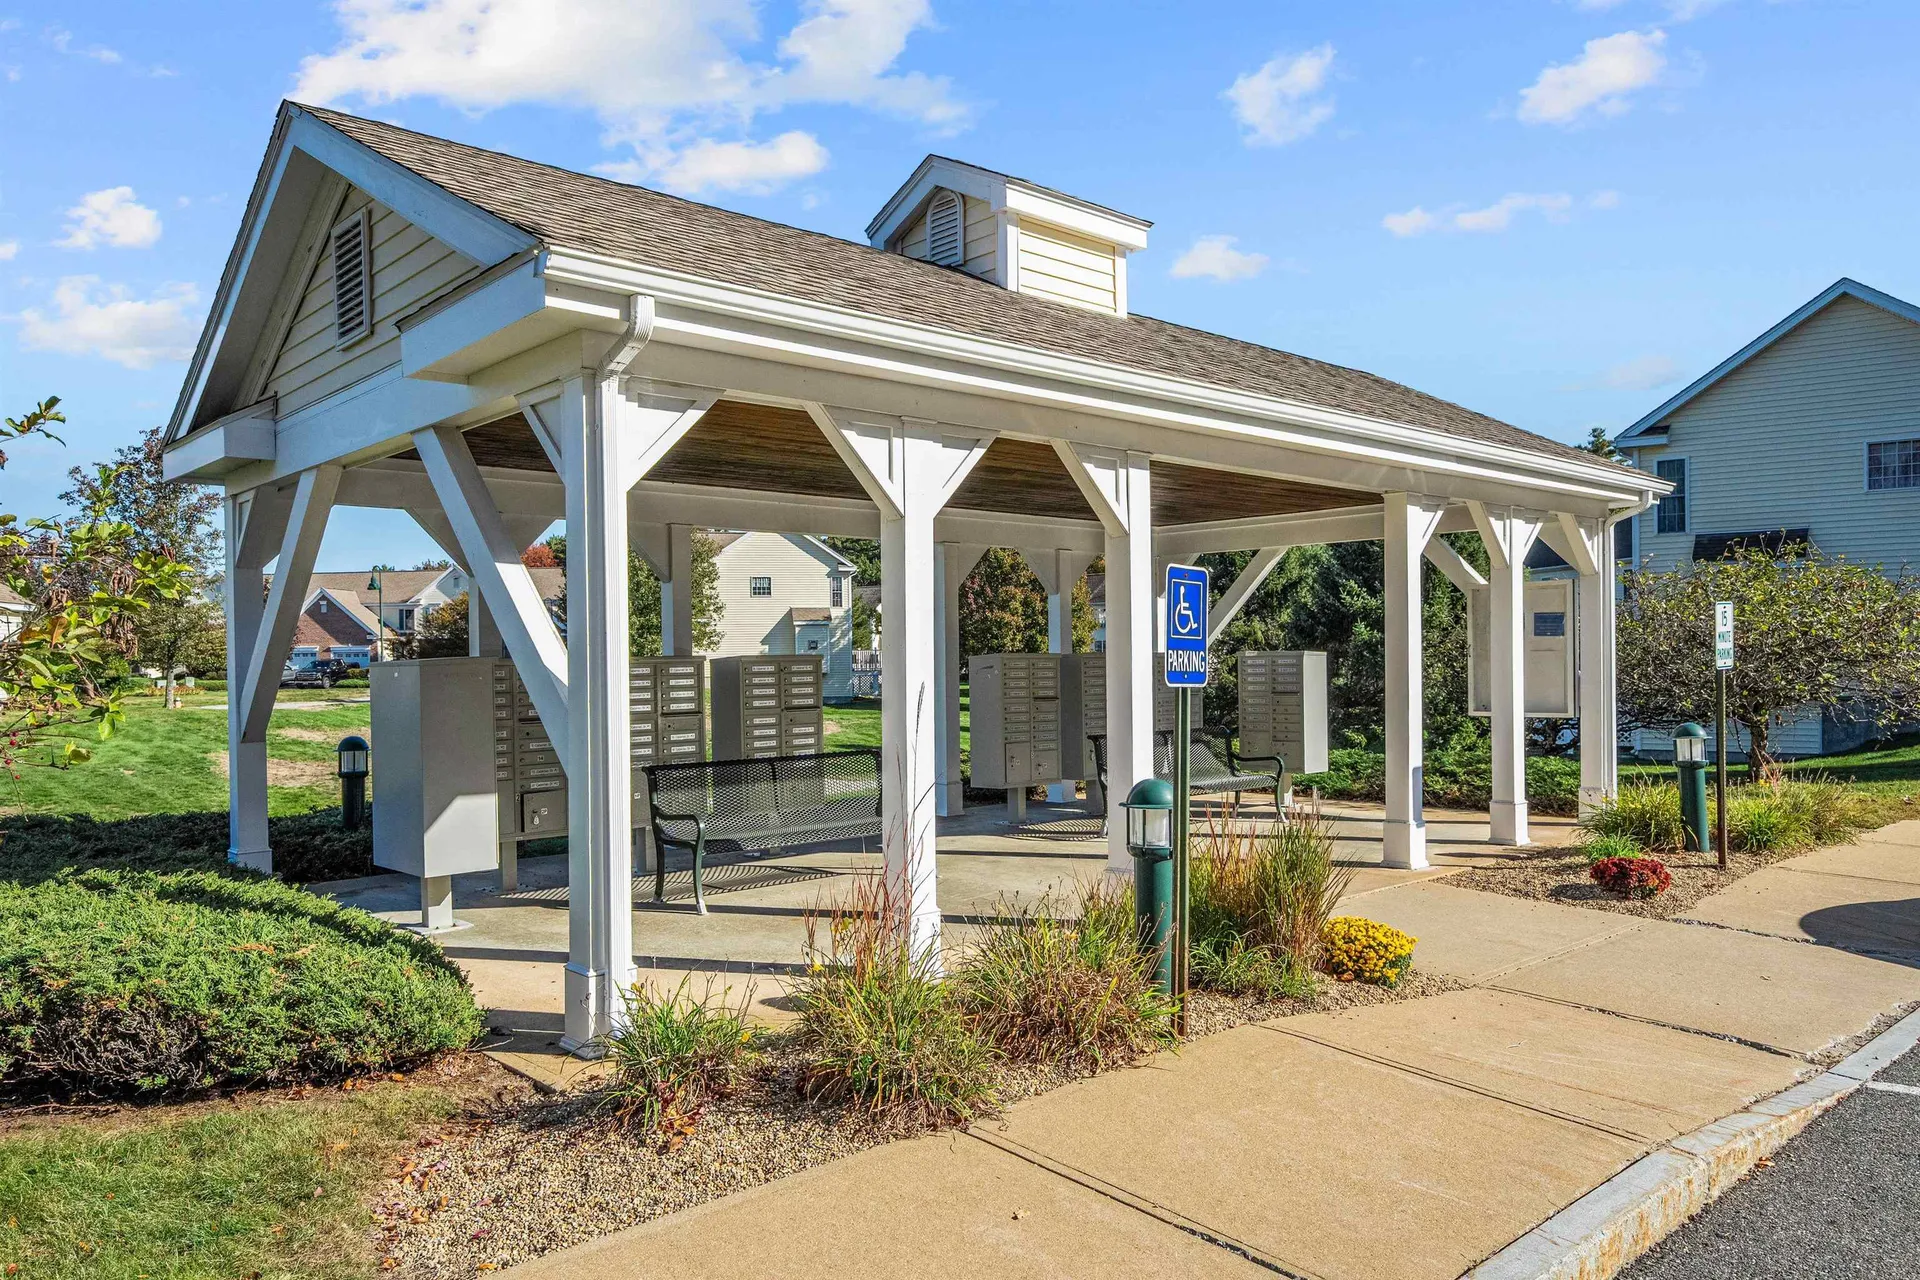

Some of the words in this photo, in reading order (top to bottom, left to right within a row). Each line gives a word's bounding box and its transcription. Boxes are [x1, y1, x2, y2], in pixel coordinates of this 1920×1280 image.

[1722, 610, 1728, 626] 15
[1718, 631, 1731, 643] MINUTE
[1717, 647, 1732, 660] PARKING
[1167, 650, 1205, 672] PARKING
